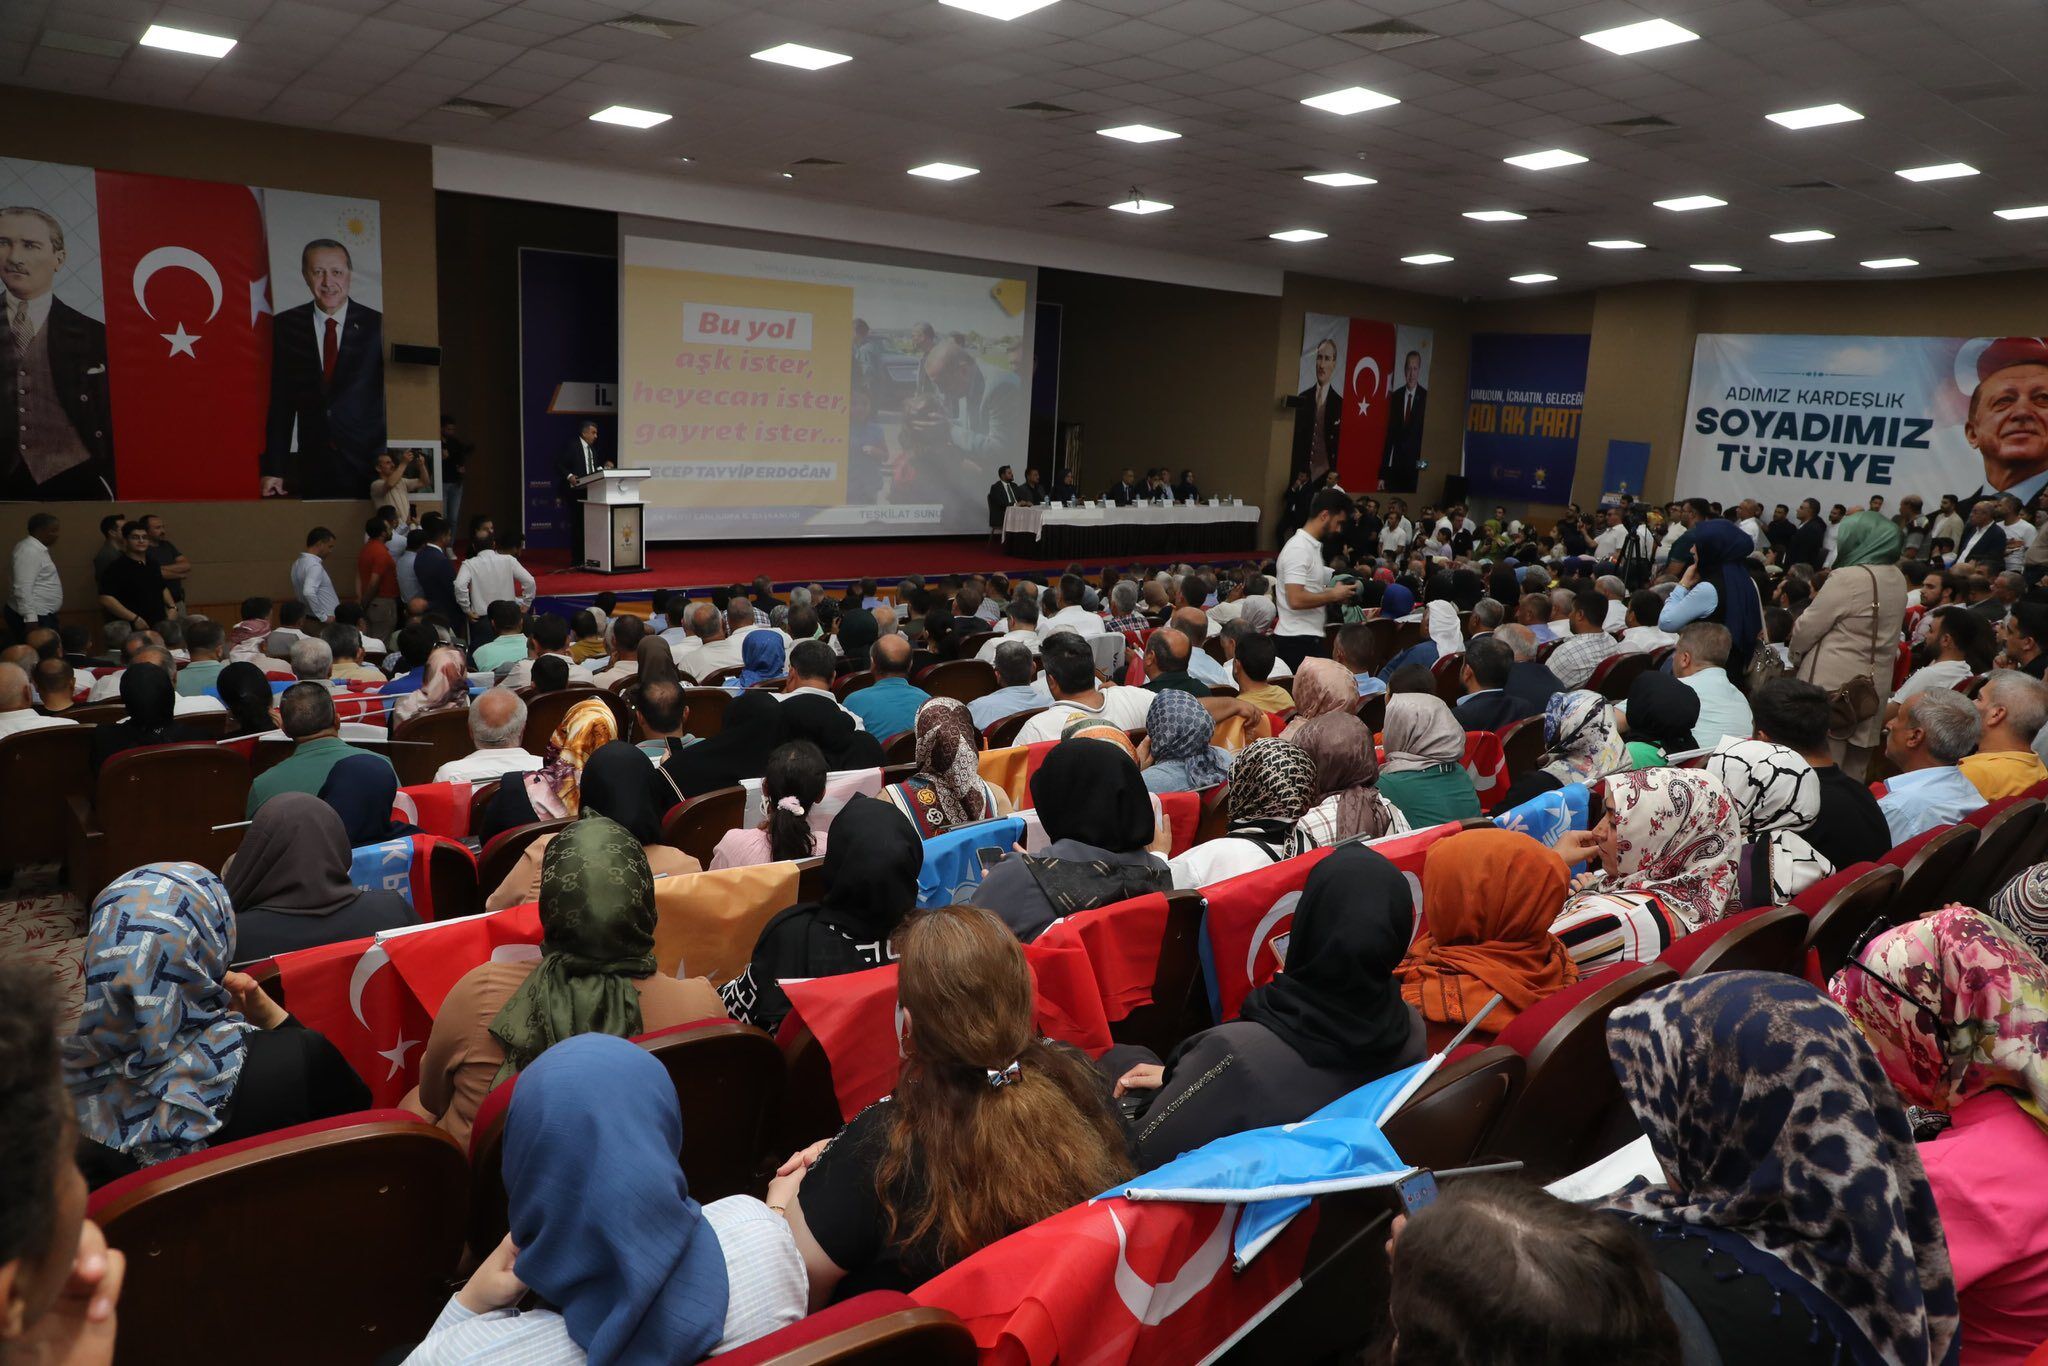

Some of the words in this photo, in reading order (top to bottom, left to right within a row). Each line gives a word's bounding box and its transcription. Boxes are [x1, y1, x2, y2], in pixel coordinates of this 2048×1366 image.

[698, 311, 740, 336] Bu
[746, 318, 796, 341] yol
[675, 348, 734, 375] aşk
[740, 350, 814, 379] ister,
[595, 384, 612, 406] İL
[633, 380, 769, 409] heyecan
[776, 387, 847, 414] ister,
[1725, 387, 1791, 403] ADIMIZ
[1796, 389, 1905, 410] KARDEŞLİK
[634, 422, 748, 445] gayret
[755, 420, 843, 443] ister...
[1467, 403, 1496, 432] ADI
[1500, 405, 1527, 435] AK
[1695, 407, 1934, 449] SOYADIMIZ
[651, 466, 694, 479] ECEP
[754, 464, 831, 479] ERDOĞAN
[1717, 443, 1896, 485] TÜRKİYE
